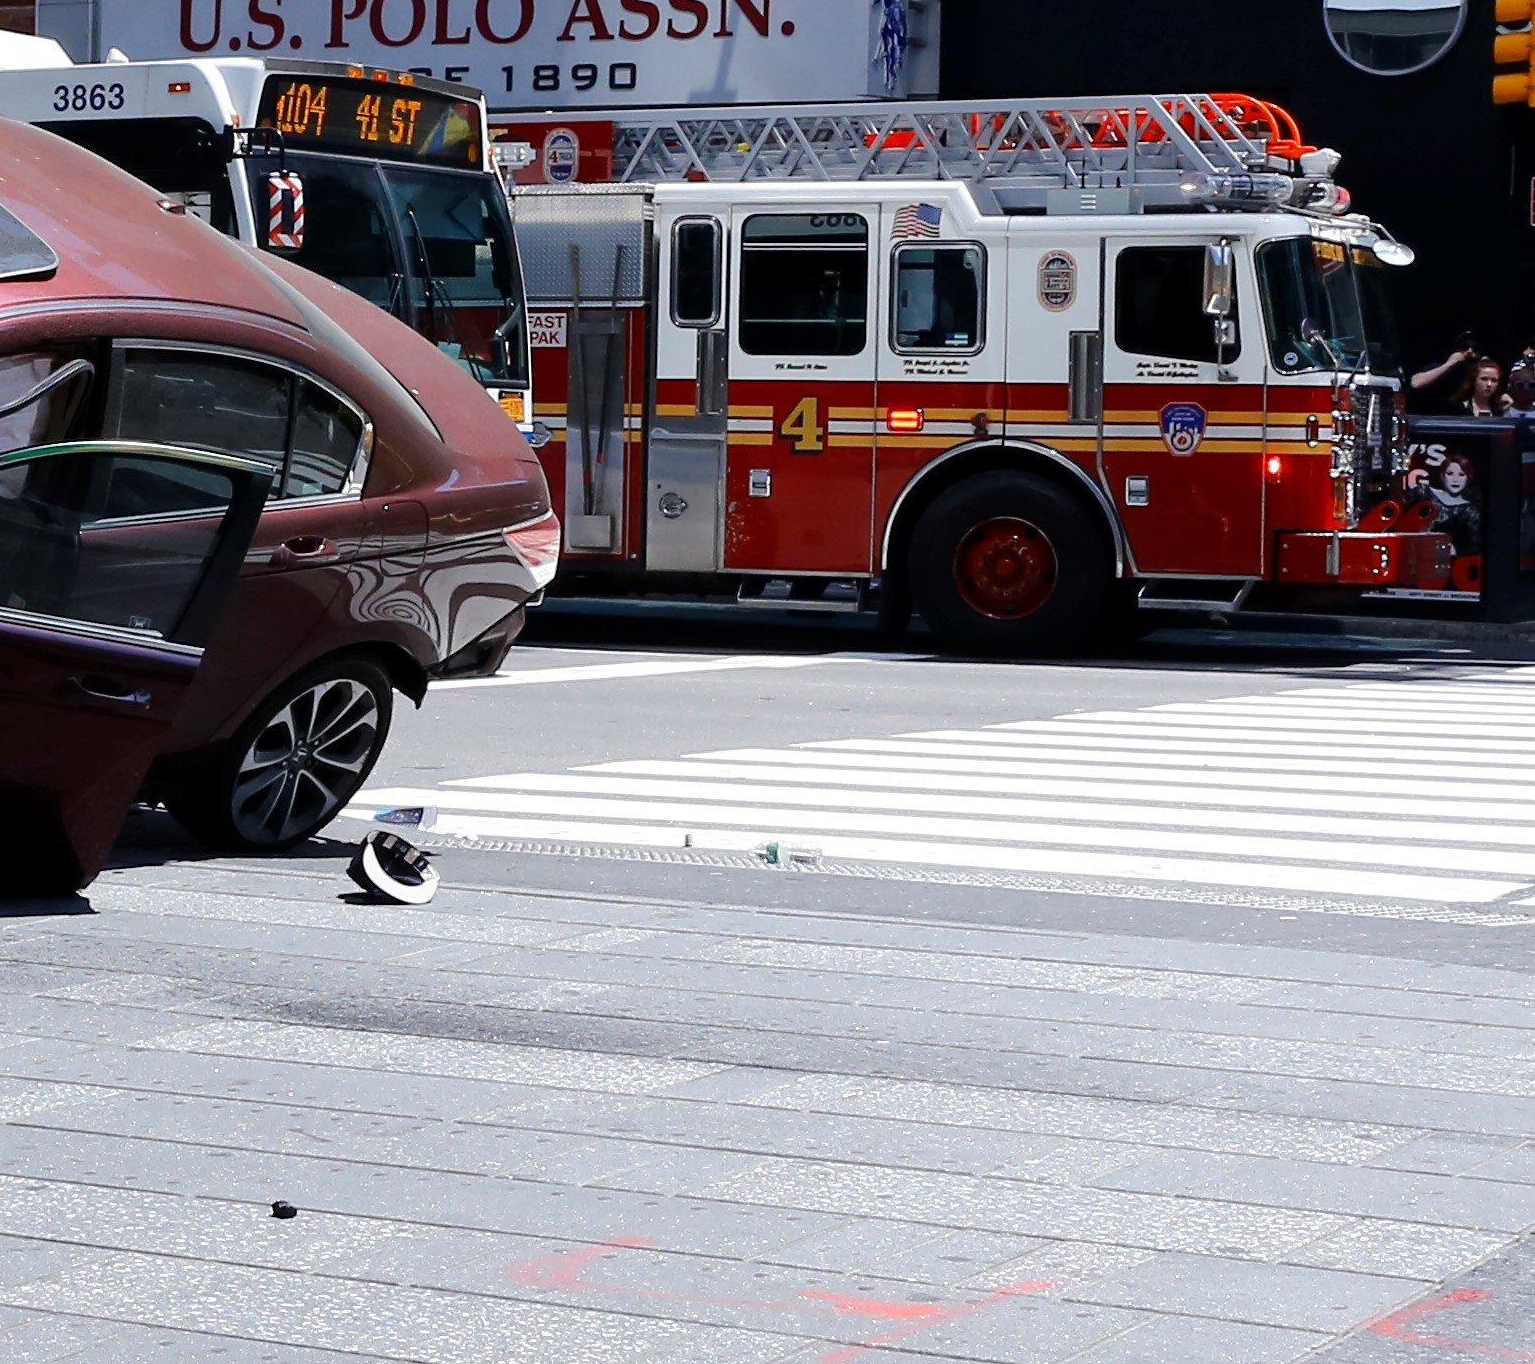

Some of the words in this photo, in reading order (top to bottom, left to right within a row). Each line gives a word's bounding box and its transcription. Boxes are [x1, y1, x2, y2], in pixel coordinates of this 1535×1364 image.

[501, 63, 638, 92] 1890
[53, 83, 124, 111] 3863
[389, 99, 422, 145] ST
[528, 316, 564, 328] FAST
[530, 332, 560, 344] PAK
[776, 395, 824, 454] 4
